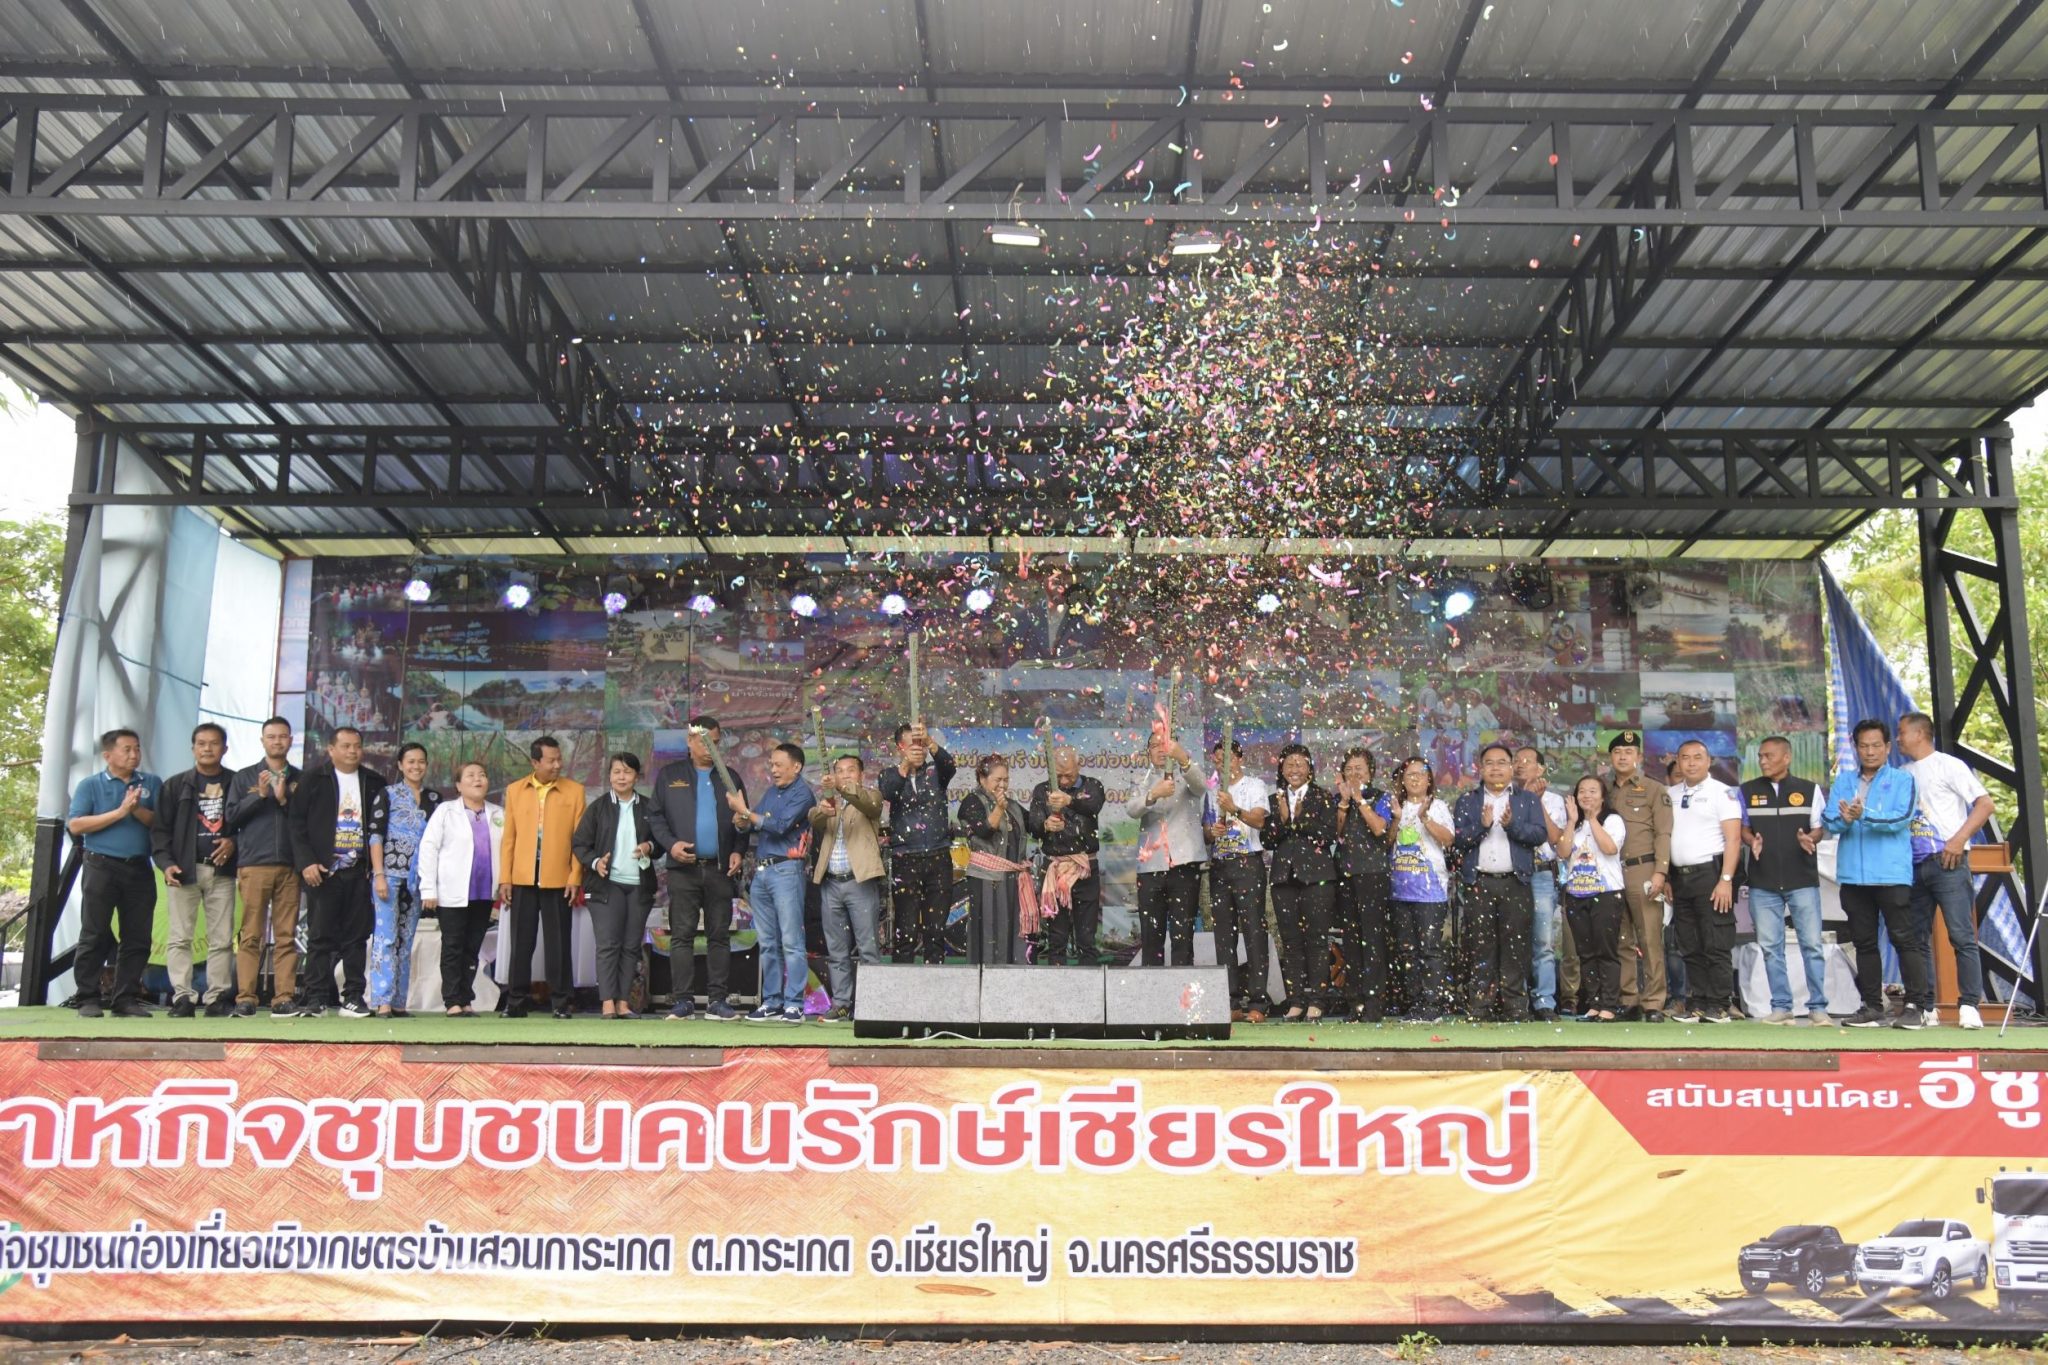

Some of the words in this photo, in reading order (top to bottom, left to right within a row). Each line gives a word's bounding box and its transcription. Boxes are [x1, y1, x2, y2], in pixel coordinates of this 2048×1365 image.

[1918, 1055, 2048, 1129] อีซู
[691, 1233, 852, 1274] ต.การะเกด
[870, 1222, 1050, 1284] อ.เชียรใหญ่
[1067, 1225, 1357, 1279] จ.นครศรีธรรมราช
